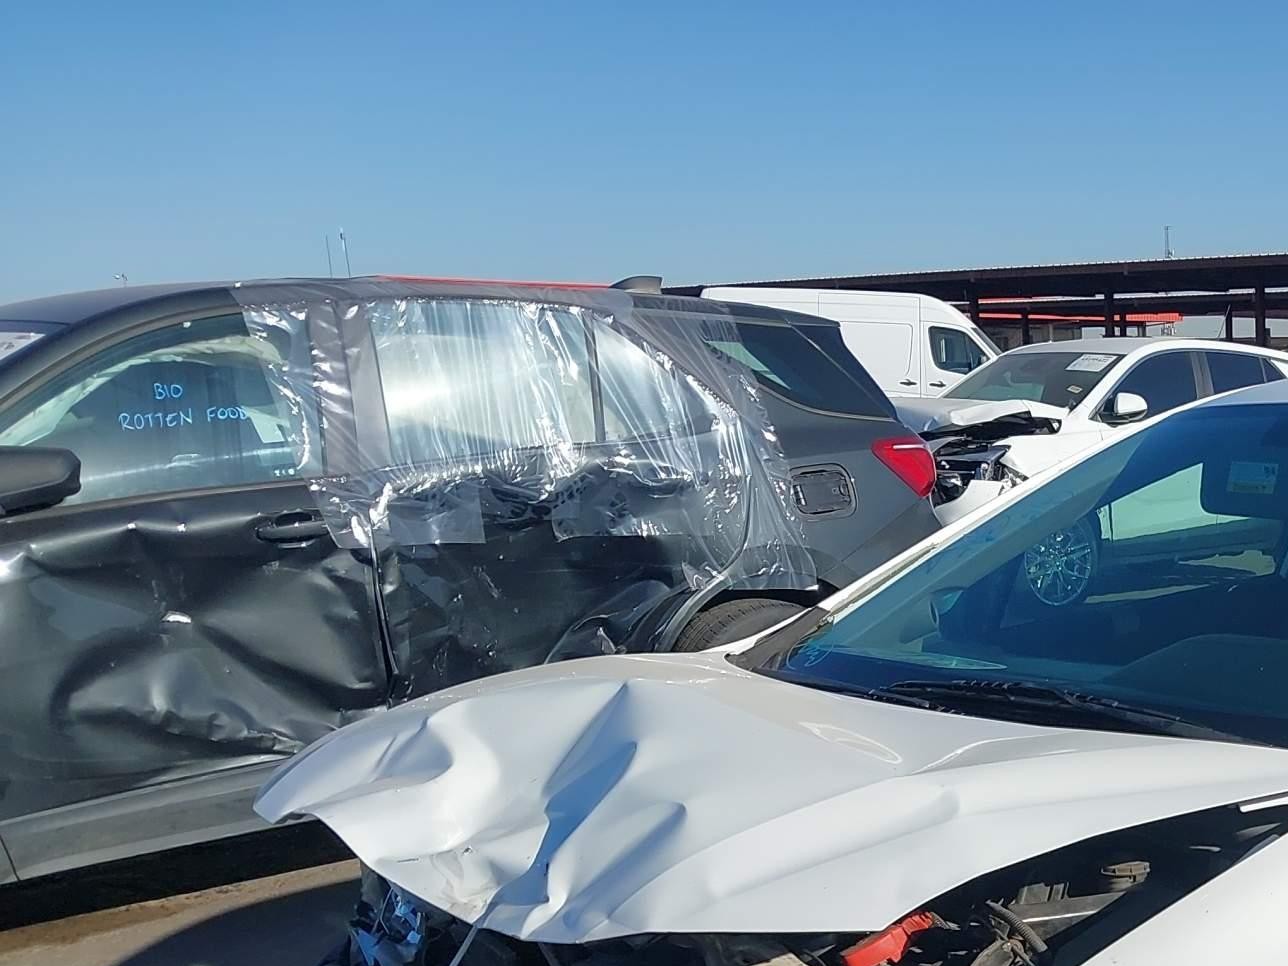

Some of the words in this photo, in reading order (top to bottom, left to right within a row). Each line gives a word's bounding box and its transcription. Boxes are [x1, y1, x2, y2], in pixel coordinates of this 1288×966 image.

[153, 383, 183, 400] BIO
[119, 408, 193, 430] ROTTEN
[206, 405, 248, 422] FOOD
